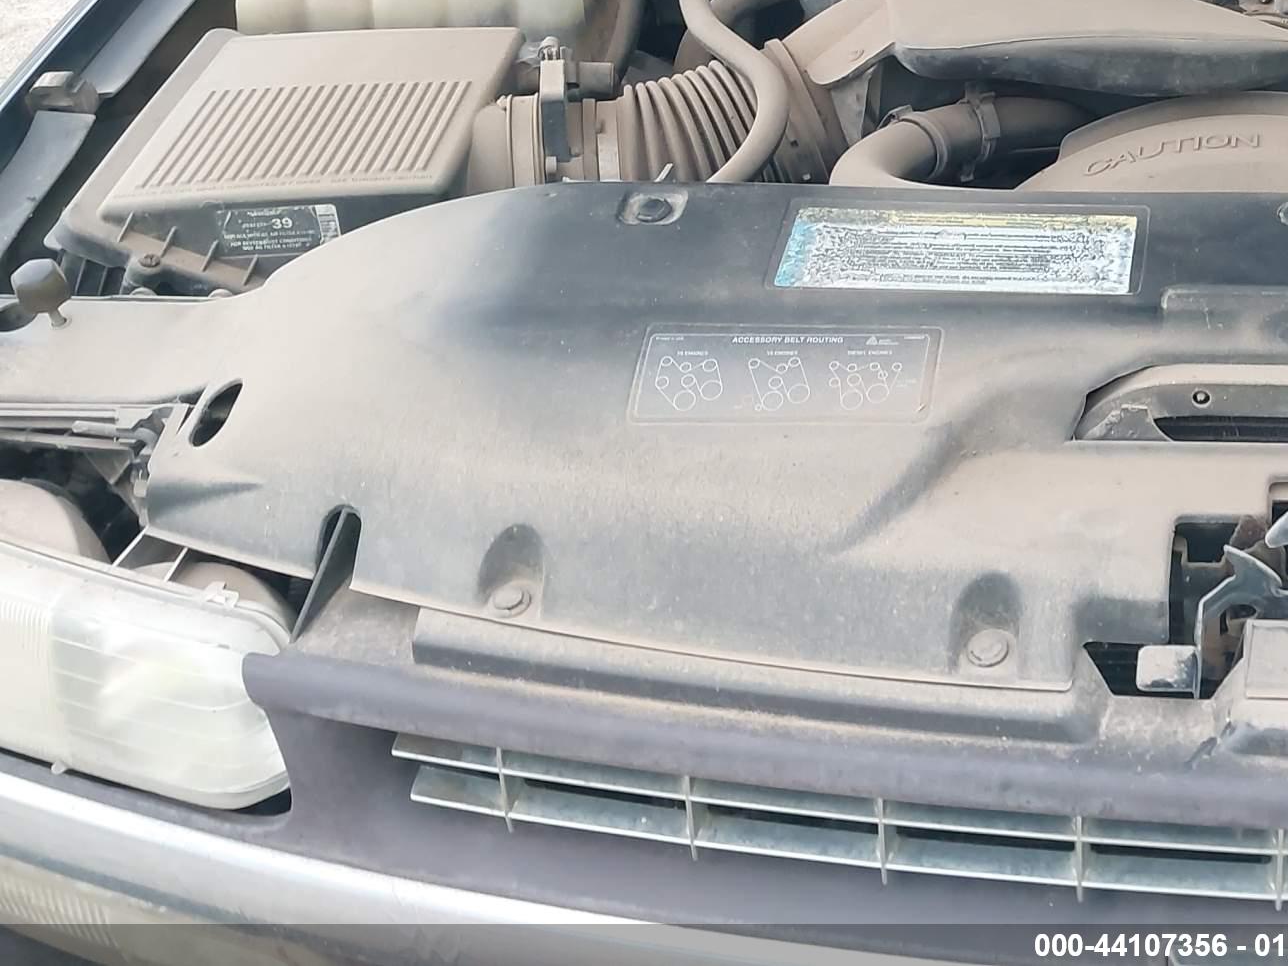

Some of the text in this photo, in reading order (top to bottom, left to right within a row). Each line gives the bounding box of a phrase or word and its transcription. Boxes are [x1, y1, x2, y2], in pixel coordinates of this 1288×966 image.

[1083, 133, 1260, 177] CAUTION
[271, 216, 293, 229] 39
[731, 336, 844, 344] ACCESSORY BELT ROUTING
